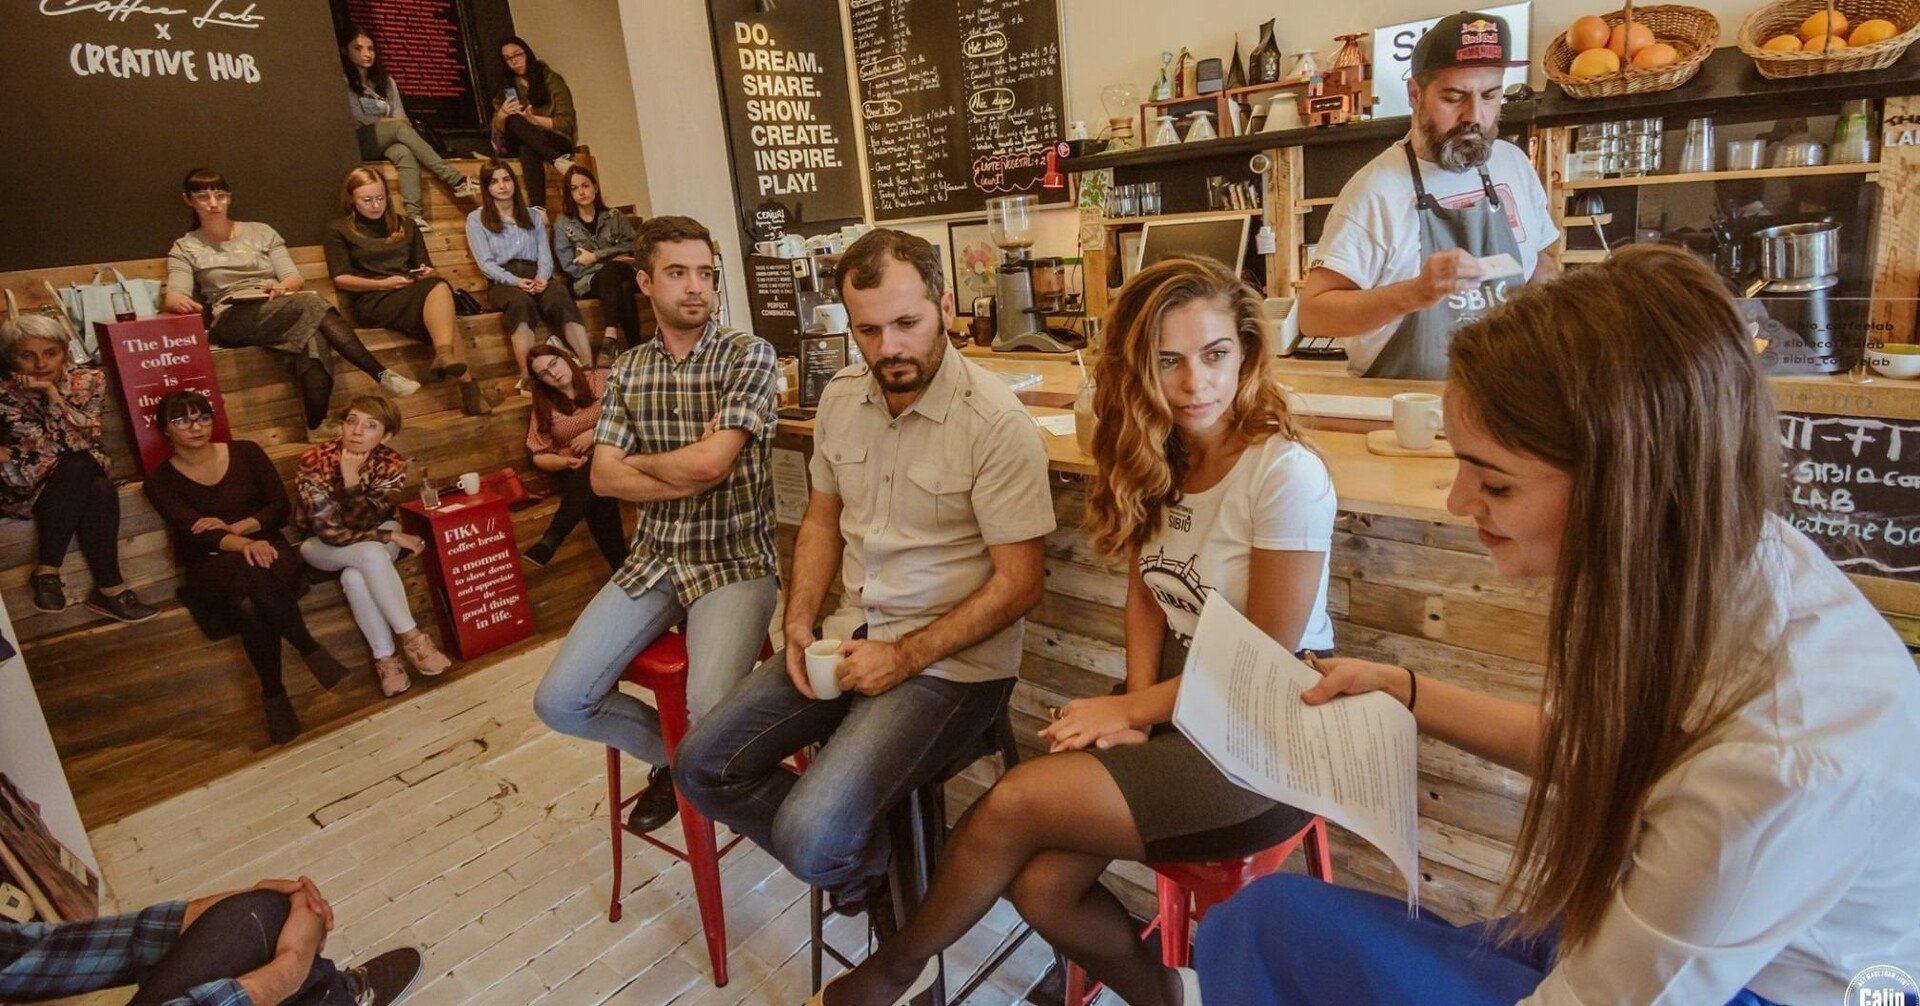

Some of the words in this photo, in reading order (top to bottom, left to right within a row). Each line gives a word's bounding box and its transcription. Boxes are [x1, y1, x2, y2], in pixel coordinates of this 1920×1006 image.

[735, 22, 776, 47] DO.
[1462, 34, 1480, 44] Red
[1481, 32, 1498, 43] Bull
[69, 42, 199, 82] CREATIVE
[206, 51, 262, 84] HUB
[738, 48, 823, 73] DREAM.
[743, 74, 822, 97] SHARE.
[746, 100, 816, 121] SHOW.
[751, 125, 840, 147] CREATE.
[754, 148, 843, 171] INSPIRE.
[758, 172, 818, 196] PLAY!
[122, 338, 158, 352] The
[162, 334, 198, 348] best
[141, 353, 190, 369] coffee
[163, 373, 179, 387] is
[1792, 484, 1857, 513] LAB
[443, 522, 480, 545] FIKA
[447, 541, 476, 556] coffee
[477, 531, 507, 547] break
[452, 565, 460, 575] a
[463, 549, 511, 572] moment
[455, 578, 464, 587] to
[466, 570, 486, 583] slow
[488, 562, 513, 575] down
[457, 587, 474, 598] and
[474, 573, 515, 596] appreciate
[482, 589, 496, 600] the
[461, 603, 488, 623] good
[489, 593, 521, 609] things
[475, 617, 490, 631] in
[491, 610, 513, 626] life.
